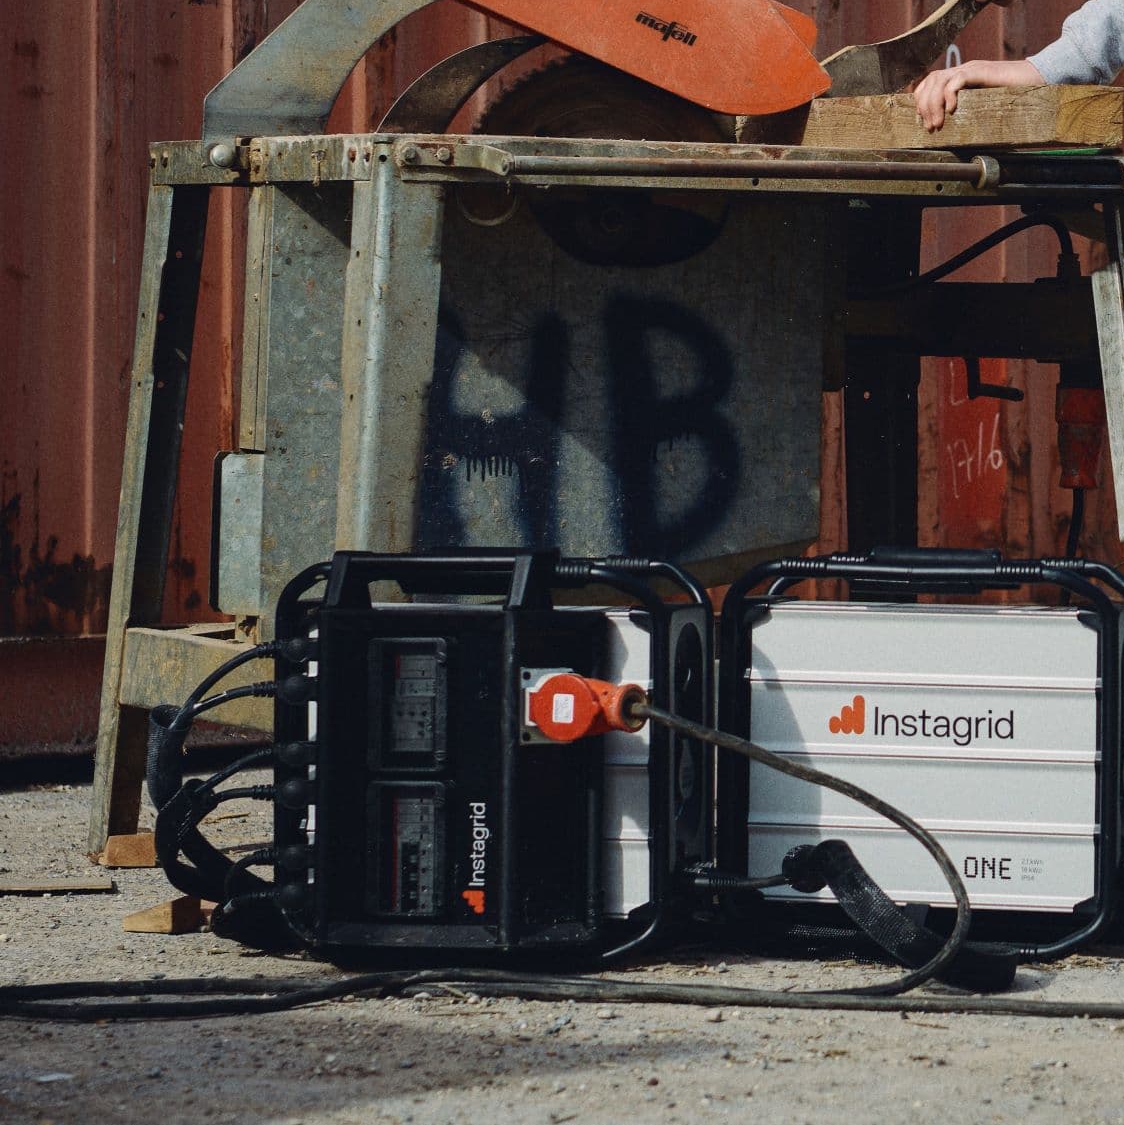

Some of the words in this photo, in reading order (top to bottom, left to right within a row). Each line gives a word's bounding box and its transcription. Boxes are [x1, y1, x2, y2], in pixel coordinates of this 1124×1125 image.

[636, 13, 698, 47] mafell
[873, 705, 1015, 747] Instagrid
[467, 801, 490, 887] Instagrid
[964, 856, 1012, 880] ONE
